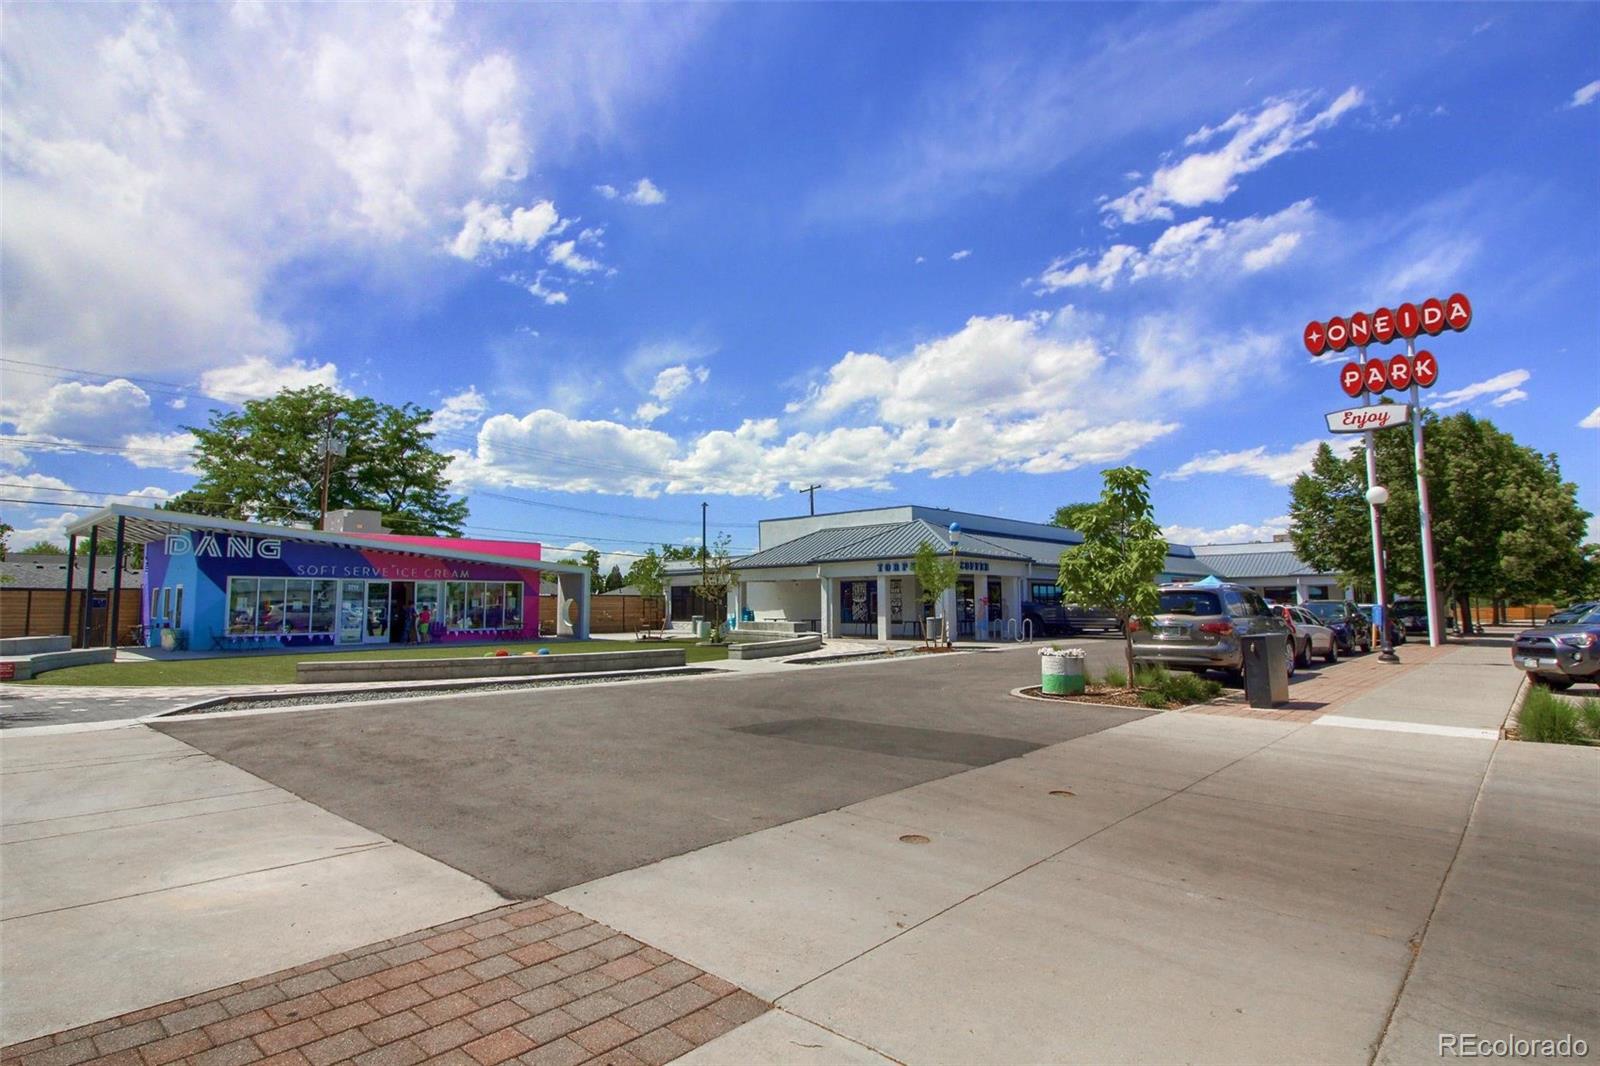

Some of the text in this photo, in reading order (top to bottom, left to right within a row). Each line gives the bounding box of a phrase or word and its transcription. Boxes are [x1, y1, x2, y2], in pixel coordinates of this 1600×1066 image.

[1327, 302, 1468, 341] ONEIDA
[1345, 358, 1433, 387] PARK
[1342, 411, 1390, 429] Enjoy
[164, 534, 281, 559] DANG
[297, 564, 470, 579] SOFT SERVE ICE CREAM
